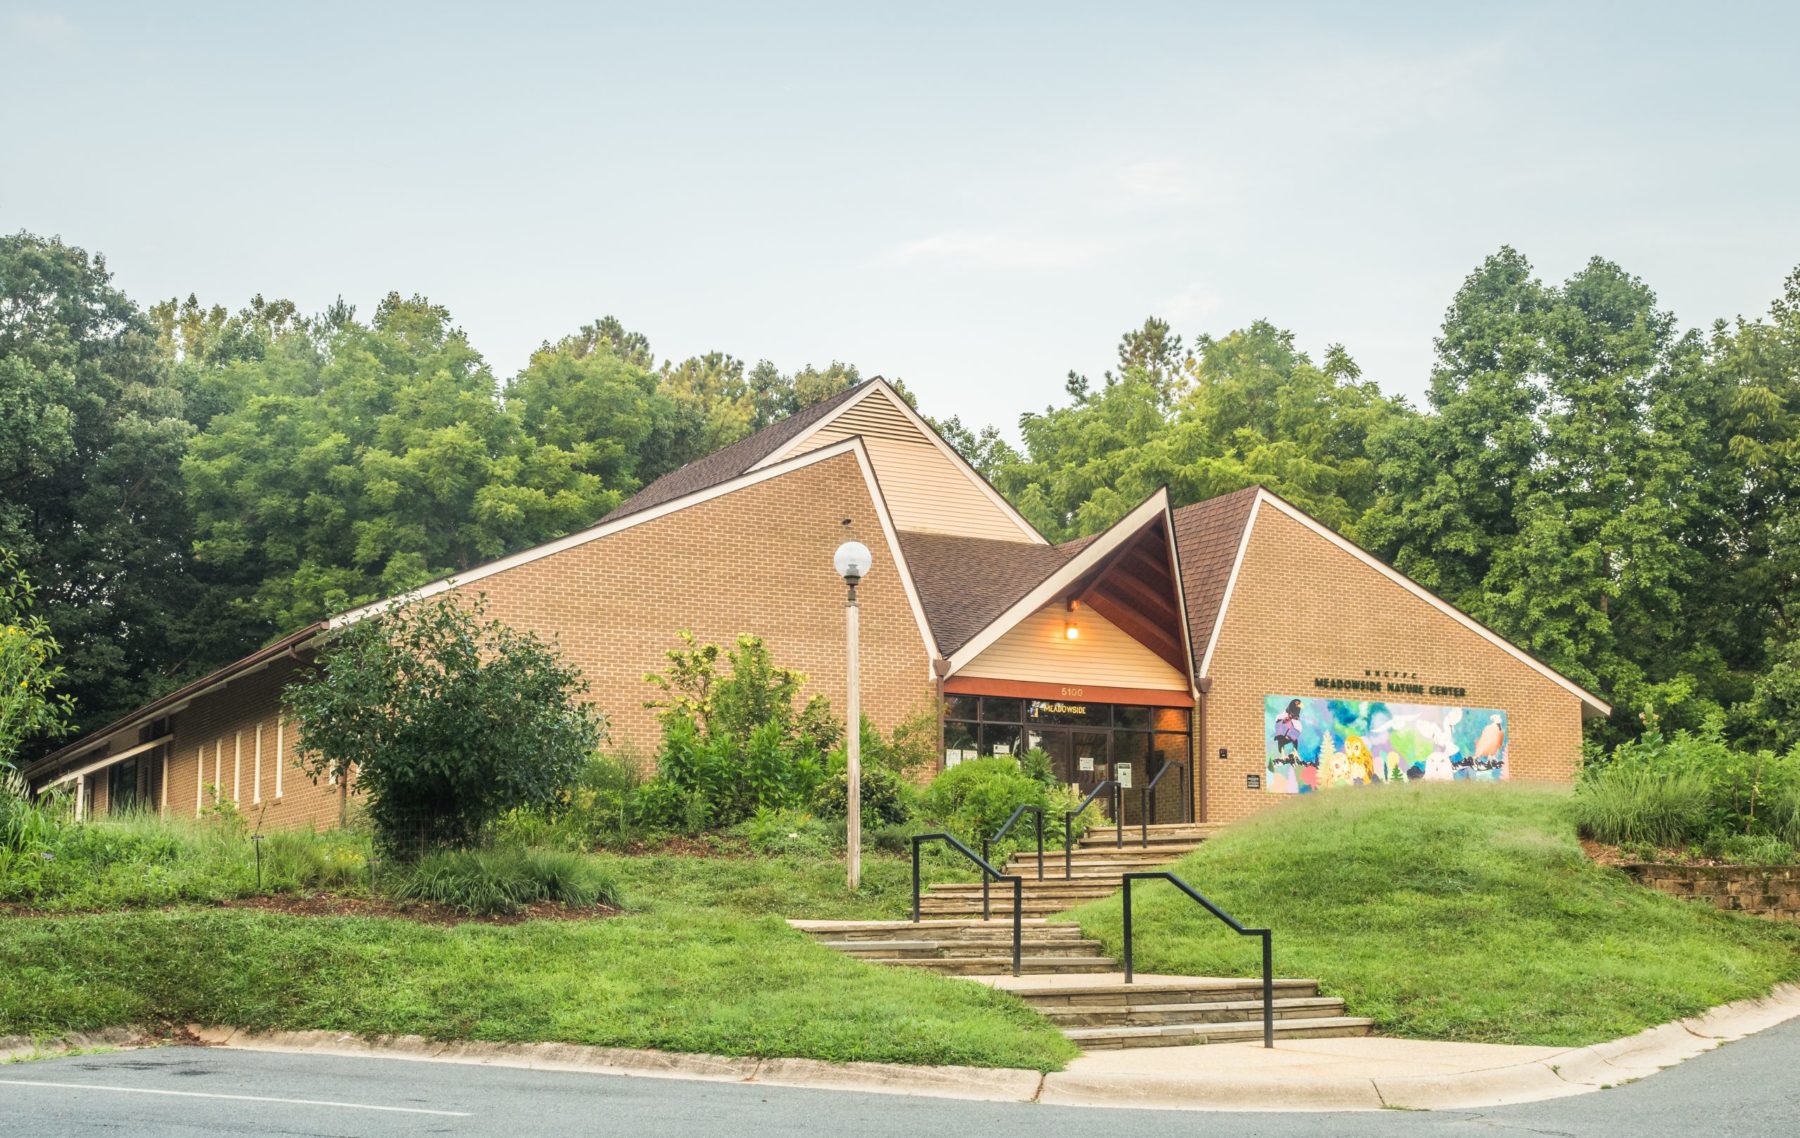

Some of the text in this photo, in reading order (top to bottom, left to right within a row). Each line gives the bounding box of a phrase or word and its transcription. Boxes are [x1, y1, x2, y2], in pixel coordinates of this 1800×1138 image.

[1061, 687, 1083, 697] 5100
[1314, 677, 1466, 697] MEADOWSIDE NATURE CENTER
[1043, 704, 1086, 714] MEADOWSIDE
